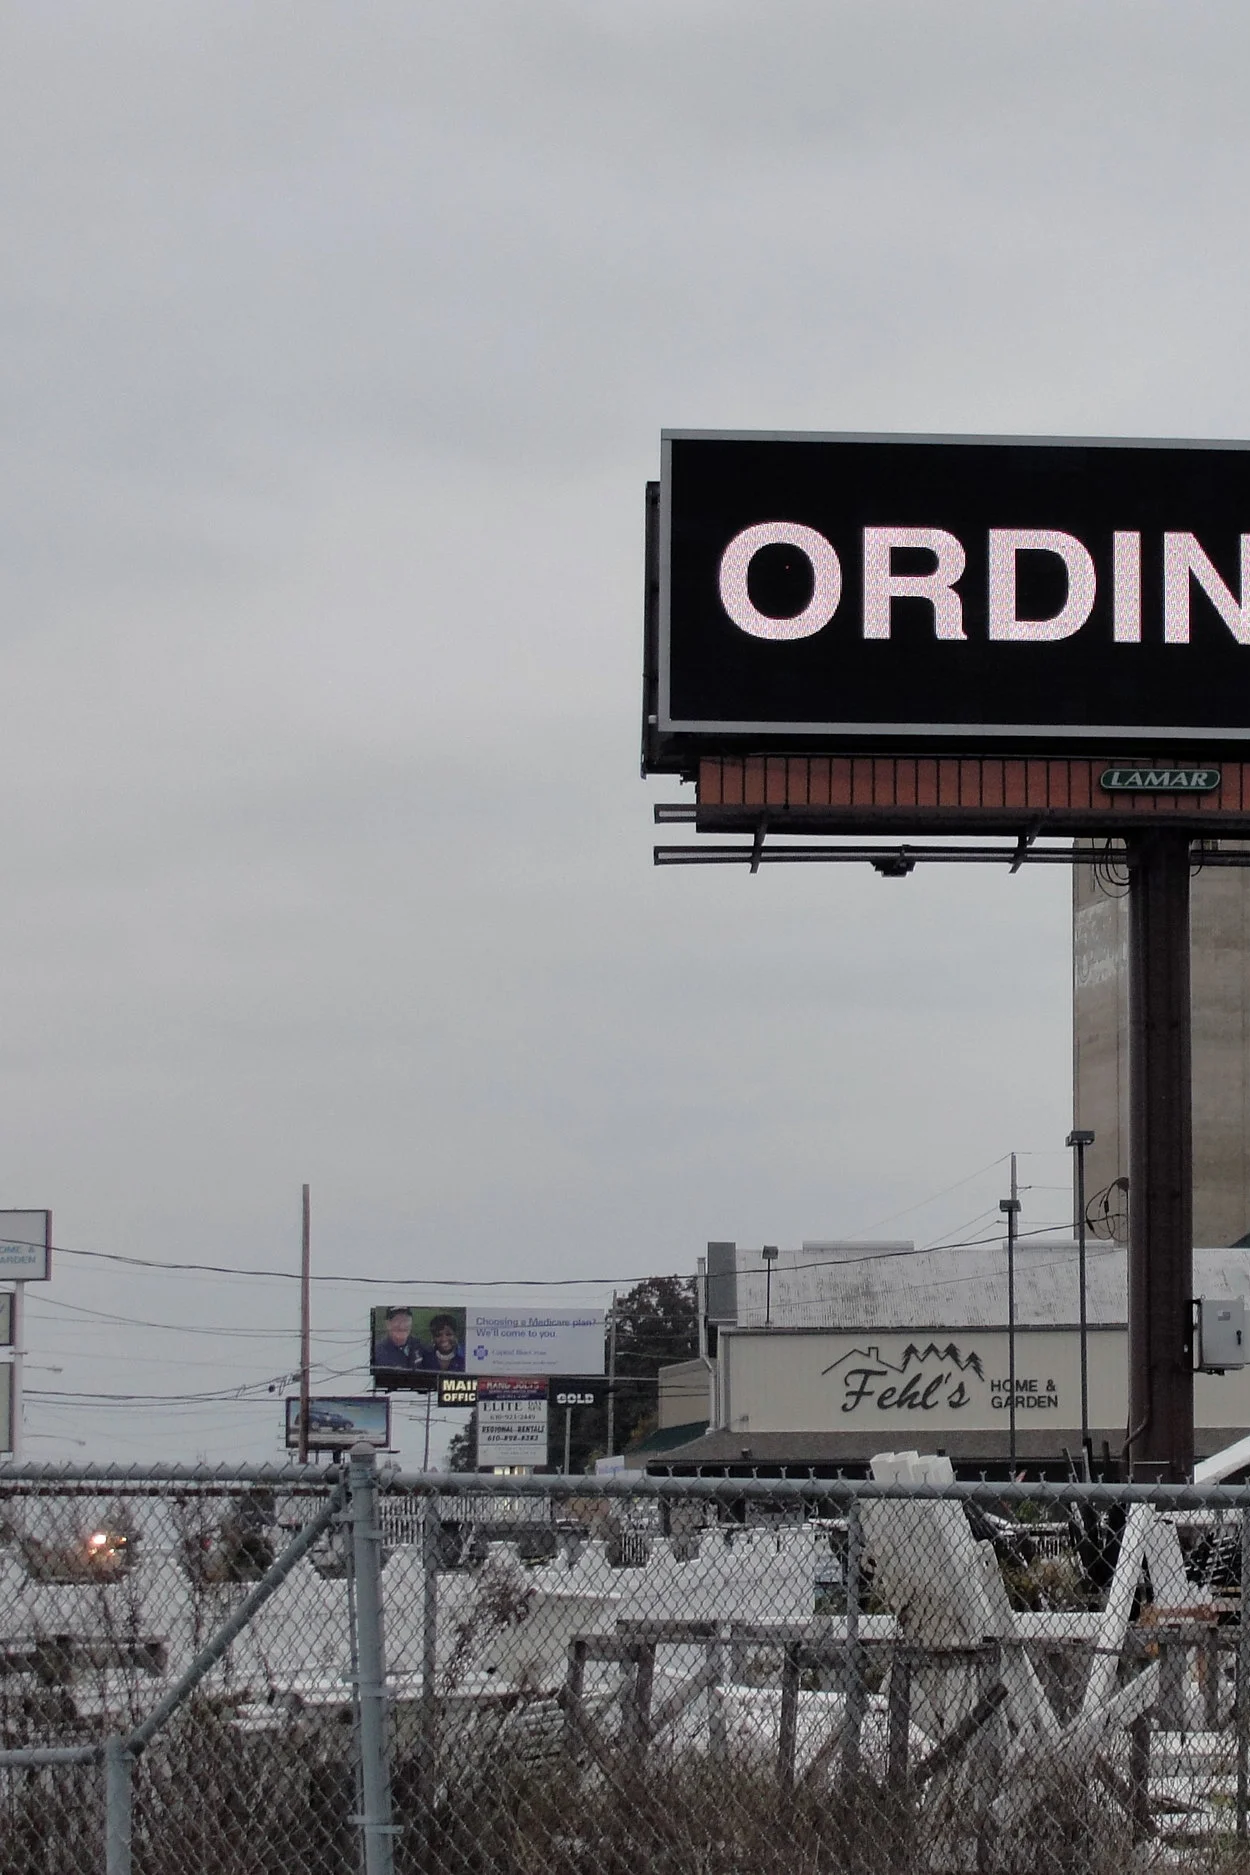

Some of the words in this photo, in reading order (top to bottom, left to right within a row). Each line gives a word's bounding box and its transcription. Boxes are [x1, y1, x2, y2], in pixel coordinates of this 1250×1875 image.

[1110, 771, 1208, 786] LAMAR
[476, 1316, 519, 1328] Choosing
[528, 1317, 569, 1327] Medicare
[476, 1328, 499, 1338] We'll
[501, 1330, 525, 1338] come
[528, 1329, 538, 1338] to
[841, 1369, 971, 1412] Fehl's
[991, 1379, 1038, 1393] HOME
[1046, 1379, 1056, 1392] &
[556, 1393, 594, 1404] GOLD
[991, 1395, 1058, 1409] GARDEN
[483, 1402, 523, 1412] ELITE
[482, 1425, 512, 1433] REGIONAL
[518, 1425, 545, 1433] RENTALS
